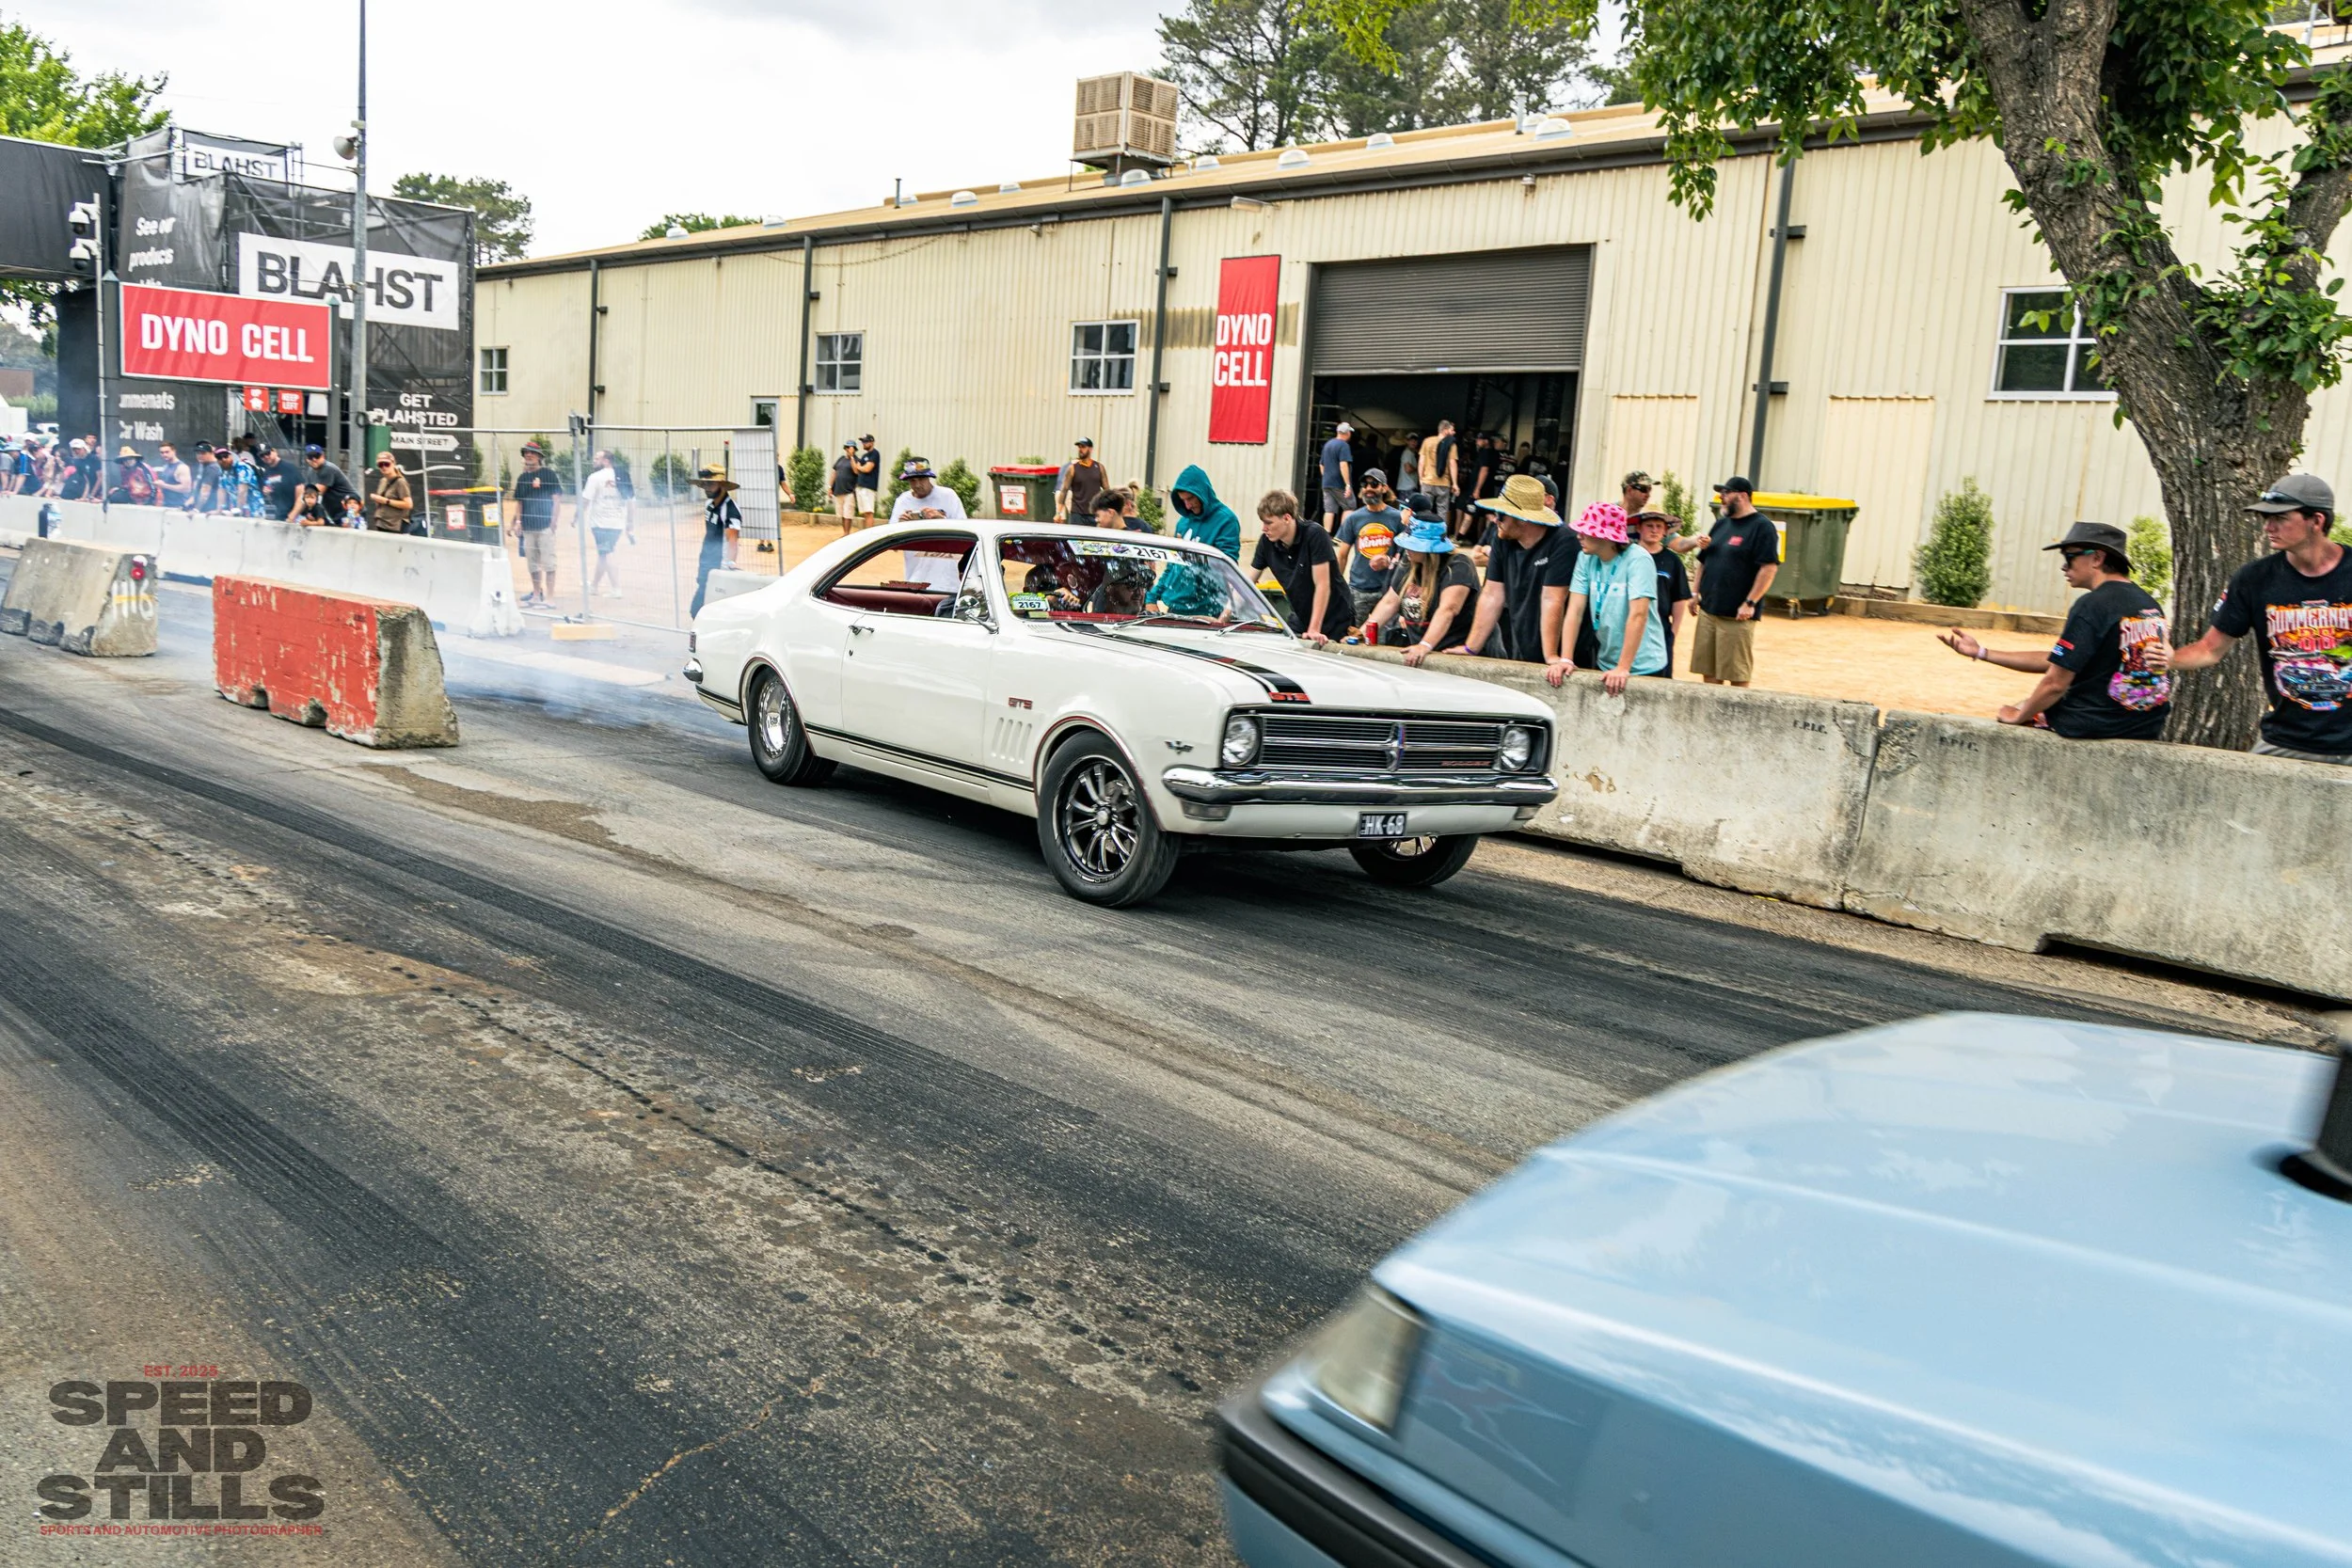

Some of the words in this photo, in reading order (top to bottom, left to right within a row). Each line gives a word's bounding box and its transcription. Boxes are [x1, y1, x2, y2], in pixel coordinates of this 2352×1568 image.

[194, 150, 278, 179] BLAHST
[257, 250, 443, 312] BLAHST
[140, 312, 229, 356] DYNO
[241, 323, 314, 363] CELL
[1216, 312, 1273, 346] DYNO
[1214, 351, 1267, 388] CELL
[399, 392, 434, 408] GET
[1133, 546, 1168, 560] 2167
[2265, 607, 2352, 638] SUMMERNA
[1009, 697, 1033, 710] GTS
